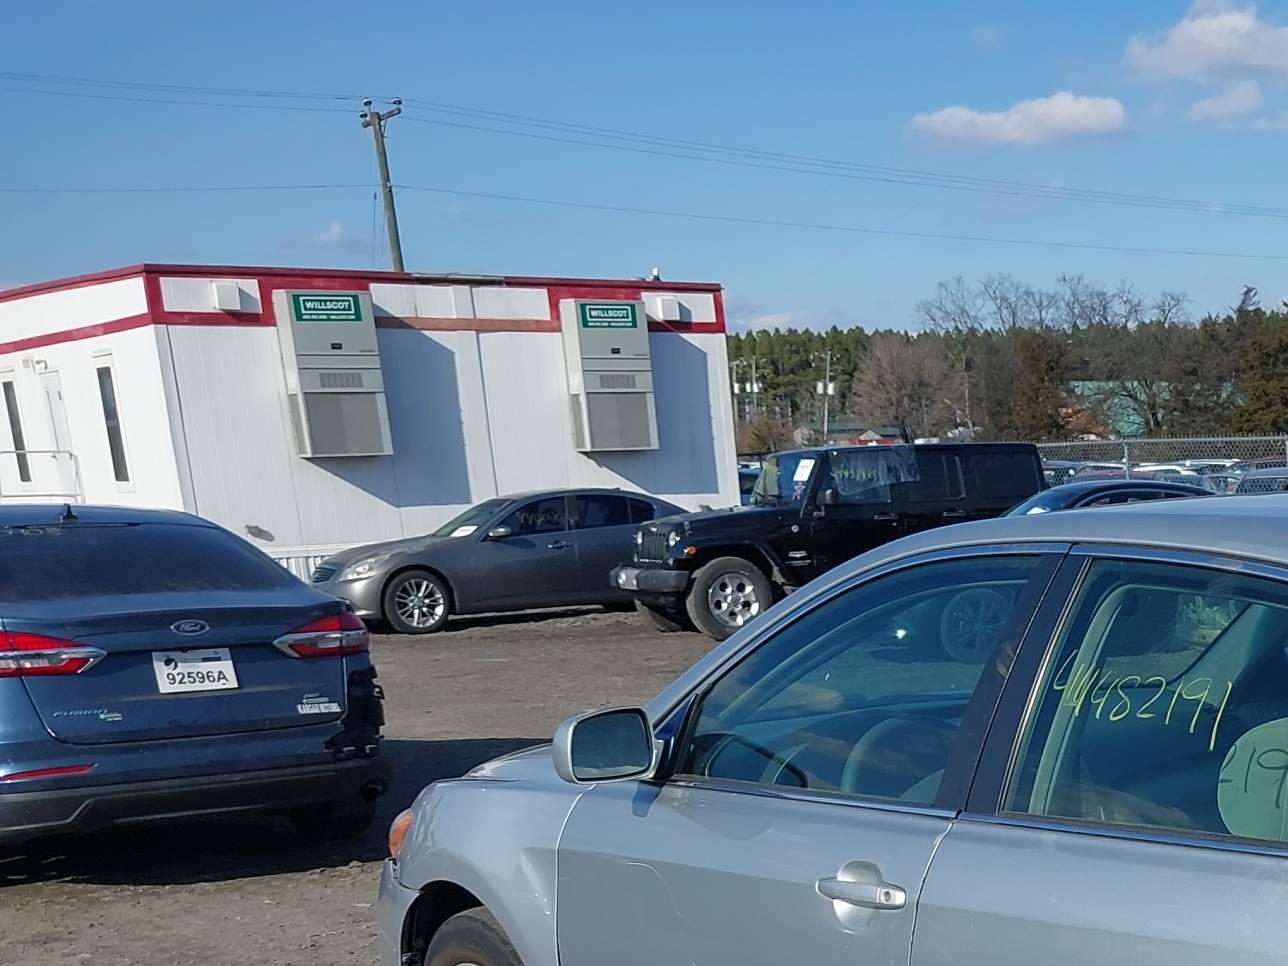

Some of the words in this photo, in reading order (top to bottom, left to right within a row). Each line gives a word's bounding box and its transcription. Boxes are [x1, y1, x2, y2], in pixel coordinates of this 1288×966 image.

[304, 301, 350, 309] WILLSCOT
[589, 309, 628, 317] WILLSCOT
[166, 669, 229, 685] 92596A
[1053, 649, 1232, 751] 44482191
